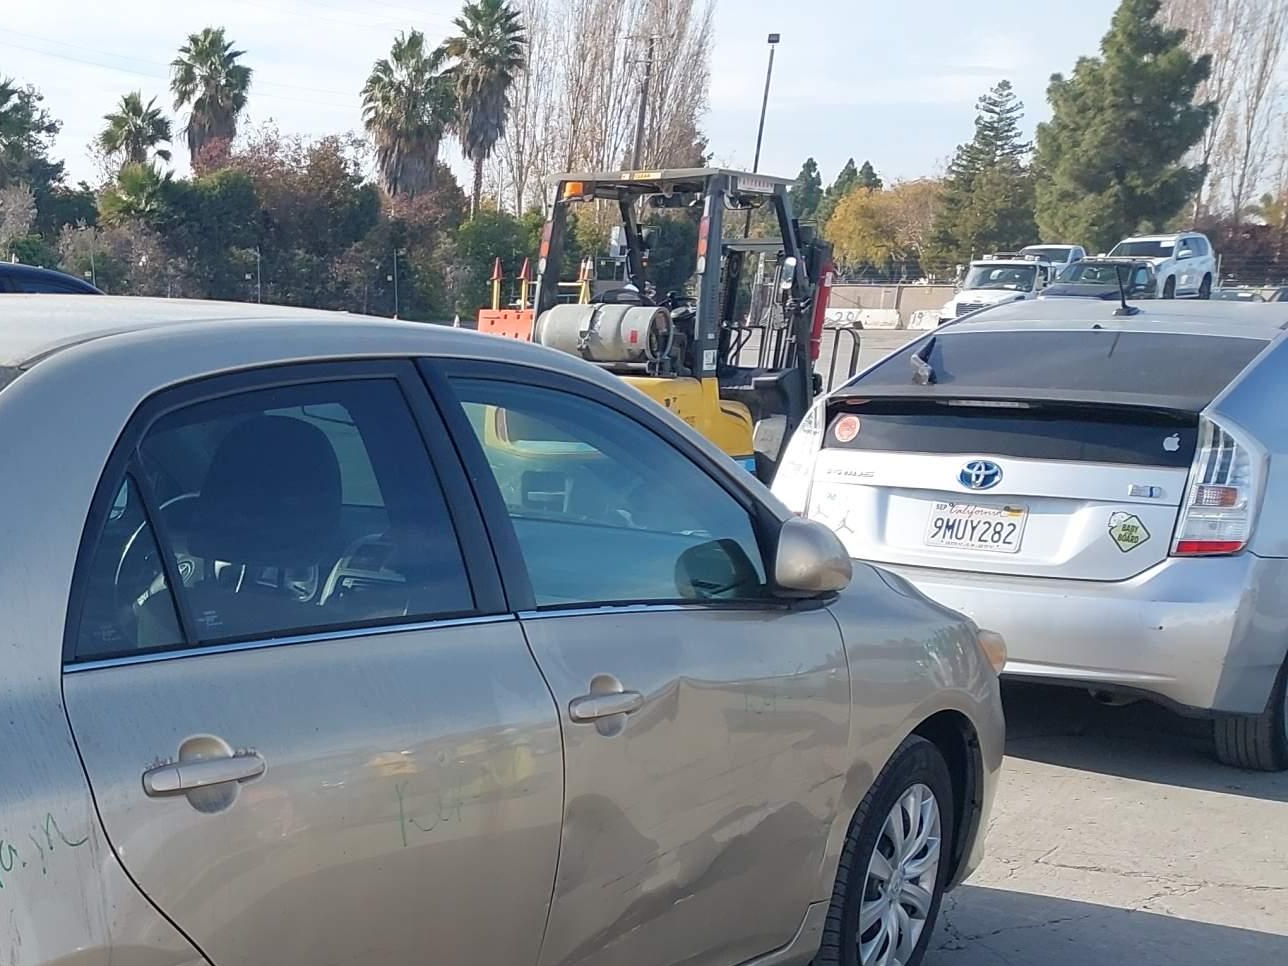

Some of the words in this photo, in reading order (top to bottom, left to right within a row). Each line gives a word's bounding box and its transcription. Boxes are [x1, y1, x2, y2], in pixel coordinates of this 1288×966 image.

[950, 503, 1006, 519] California
[931, 517, 1017, 545] 9MUY282
[1121, 523, 1140, 534] BABY
[1117, 533, 1140, 544] BOARD
